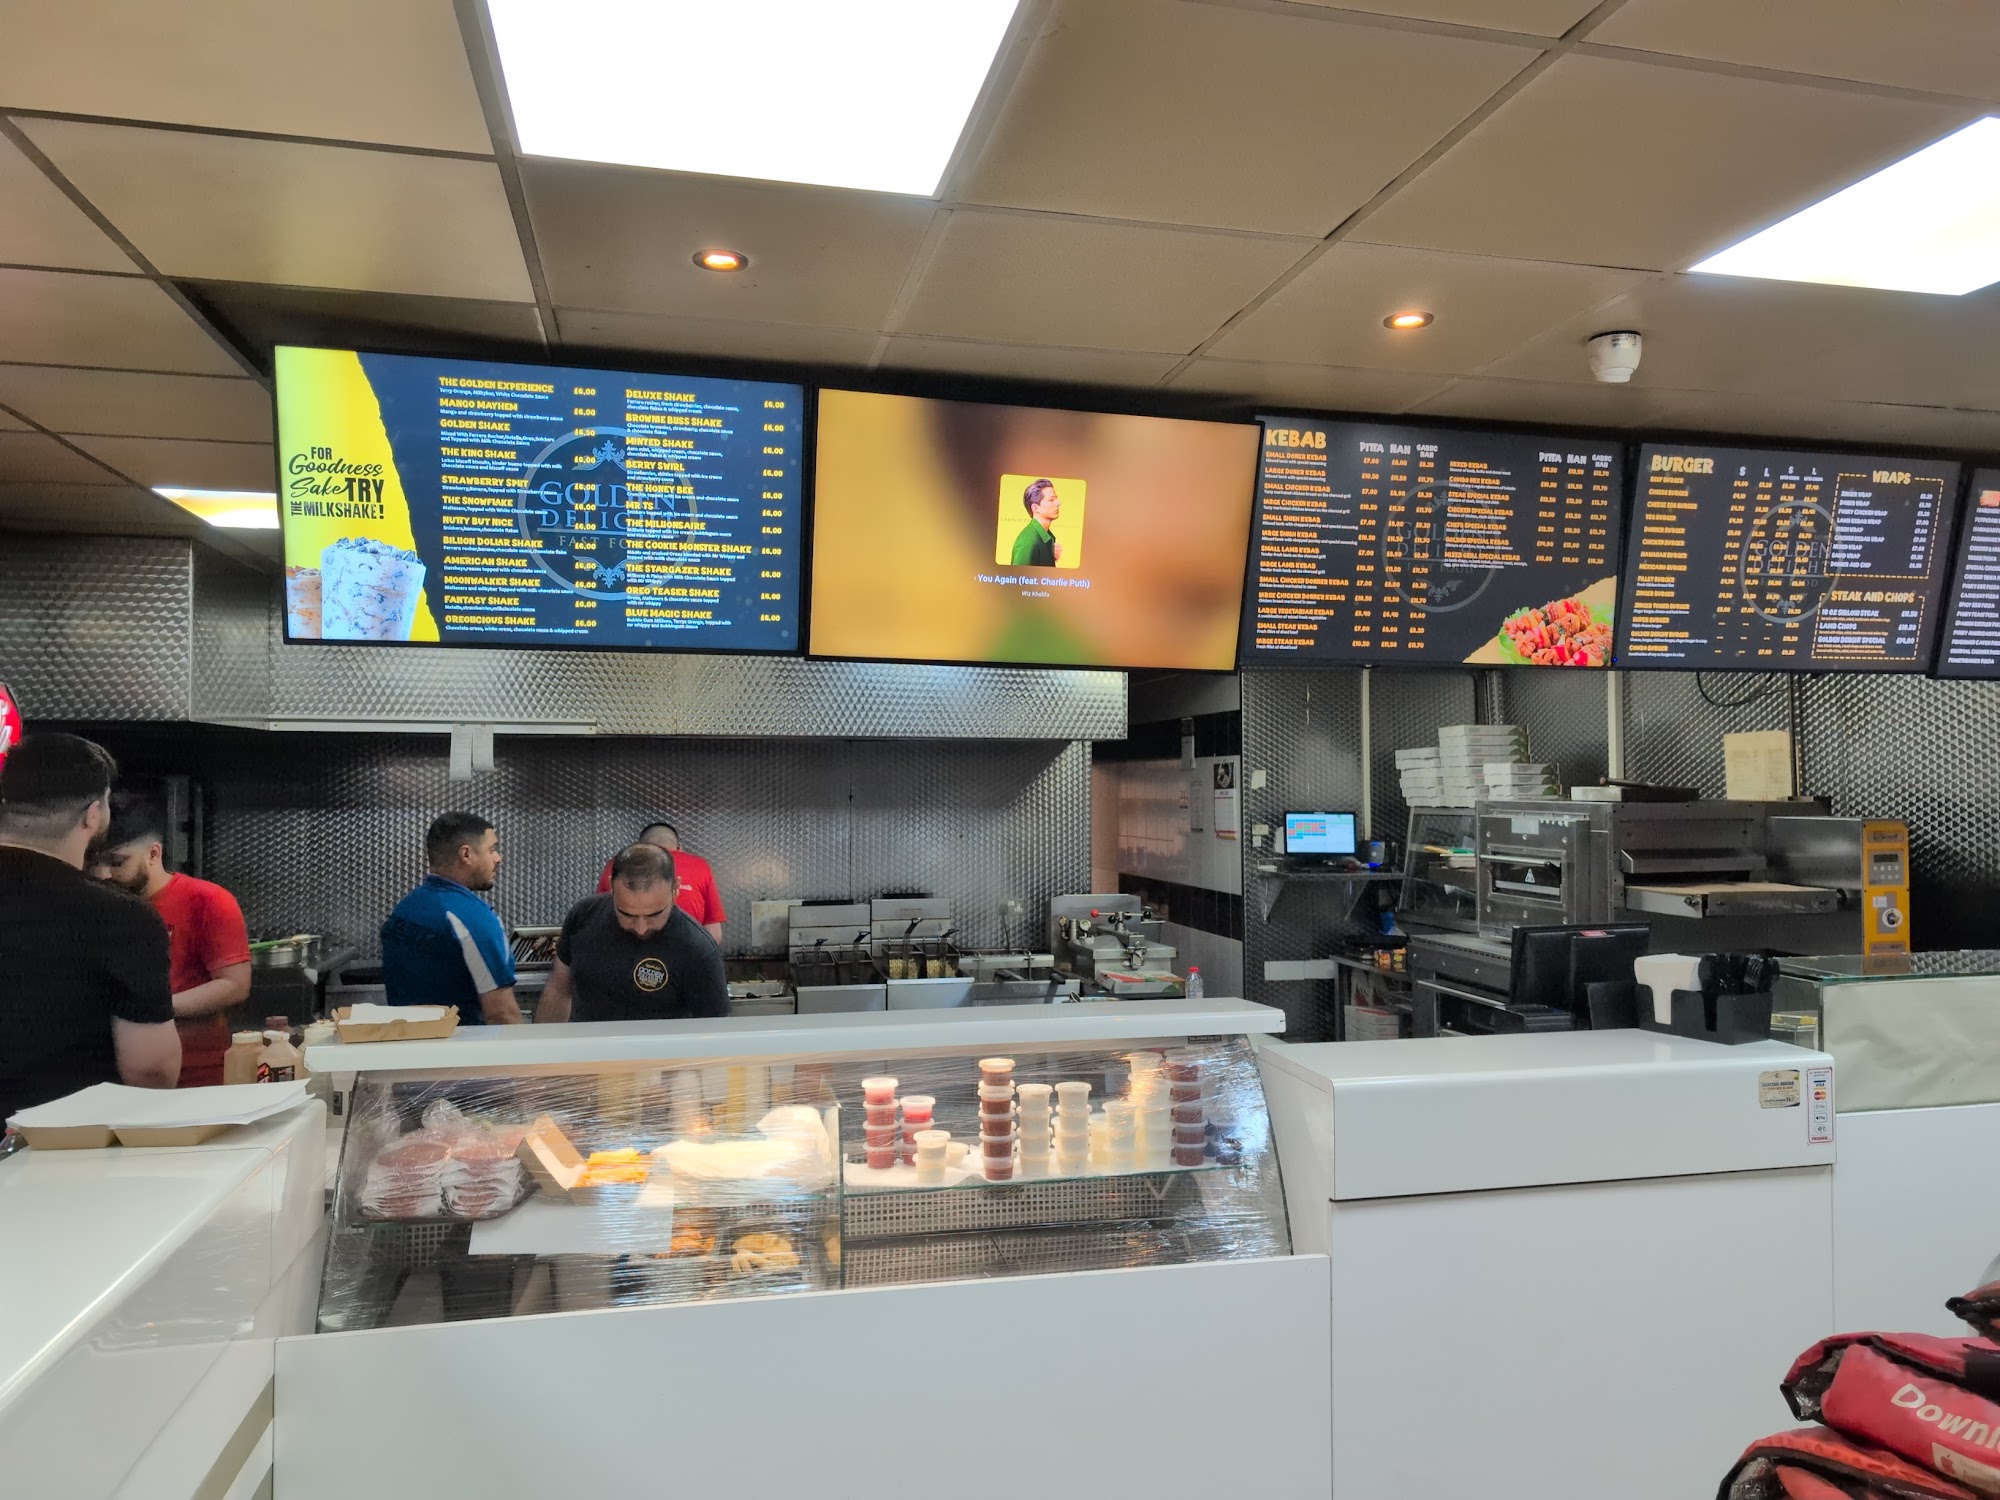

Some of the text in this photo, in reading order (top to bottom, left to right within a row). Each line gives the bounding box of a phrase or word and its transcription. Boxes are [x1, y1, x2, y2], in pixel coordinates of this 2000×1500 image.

[439, 377, 554, 393] THE GOLDEN EXPERIENCE
[574, 388, 596, 396] £6.00
[626, 390, 695, 402] DELUXE SHAKE
[440, 398, 518, 411] MANGO MAYHEM
[764, 401, 784, 409] £6.00
[574, 408, 596, 416] £6.00
[440, 419, 510, 431] GOLDEN SHAKE
[626, 413, 666, 424] BROWNIE
[691, 417, 722, 427] SHAKE
[574, 429, 595, 437] £6.50
[764, 424, 784, 432] £6.00
[626, 437, 694, 449] MINTED SHAKE
[1265, 429, 1327, 449] KEBAB
[311, 447, 332, 460] FOR
[441, 447, 516, 459] THE KING SHAKE
[763, 447, 783, 455] £6.00
[1359, 442, 1411, 455] PITTA NAN
[574, 456, 596, 464] £6.00
[1266, 451, 1287, 459] SMALL
[1307, 453, 1327, 461] KEBAB
[1420, 451, 1434, 459] NAN
[1539, 452, 1587, 465] PITTA NAN
[288, 454, 383, 477] Goodness
[626, 460, 685, 471] BERRY SWIRL
[1651, 455, 1714, 474] BURGER
[763, 469, 783, 477] £6.00
[1265, 467, 1284, 475] LARGE
[1306, 469, 1326, 477] KEBAB
[1739, 466, 1746, 476] S
[1764, 467, 1770, 477] L
[441, 476, 504, 486] STRAWBERRY
[1872, 470, 1911, 484] WRAPS
[290, 477, 384, 503] Sake TRY
[626, 483, 694, 494] THE HONEY BEE
[1286, 484, 1309, 492] CHICKEN
[1310, 485, 1330, 493] KEBAB
[763, 492, 783, 500] £6.00
[442, 496, 513, 507] THE SNOWFLAKE
[626, 501, 640, 509] MR
[291, 501, 384, 520] THE MILKSHAKE!
[574, 503, 596, 511] £6.00
[762, 509, 782, 518] £6.00
[1263, 514, 1282, 522] SMALL
[442, 516, 513, 527] NUTTY BUT NICE
[626, 519, 644, 528] THE
[574, 523, 596, 531] £6.00
[762, 526, 782, 535] £6.00
[511, 539, 543, 548] SHAKE
[574, 542, 596, 550] £6.00
[626, 540, 752, 554] THE COOKIE MONSTER SHAKE
[762, 547, 782, 555] £6.00
[1261, 545, 1281, 553] SMALL
[1299, 546, 1320, 554] KEBAB
[444, 556, 527, 567] AMERICAN SHAKE
[575, 562, 596, 570] £6.00
[626, 564, 731, 576] THE STARGAZER SHAKE
[761, 571, 781, 579] £6.00
[444, 576, 540, 587] MOONWALKER SHAKE
[575, 581, 596, 589] £6.00
[978, 574, 1090, 588] You Again (feat. Charlie Puth)
[626, 586, 719, 597] OREO TEASER SHAKE
[761, 592, 781, 600] £6.00
[444, 595, 519, 606] FANTASY SHAKE
[1831, 591, 1915, 603] STEAK AND CHOPS
[575, 601, 597, 609] £6.00
[626, 608, 712, 620] BLUE MAGIC SHAKE
[760, 614, 780, 622] £6.00
[505, 616, 535, 626] SHAKE
[575, 619, 596, 627] £6.00
[1891, 1383, 2000, 1453] Downl
